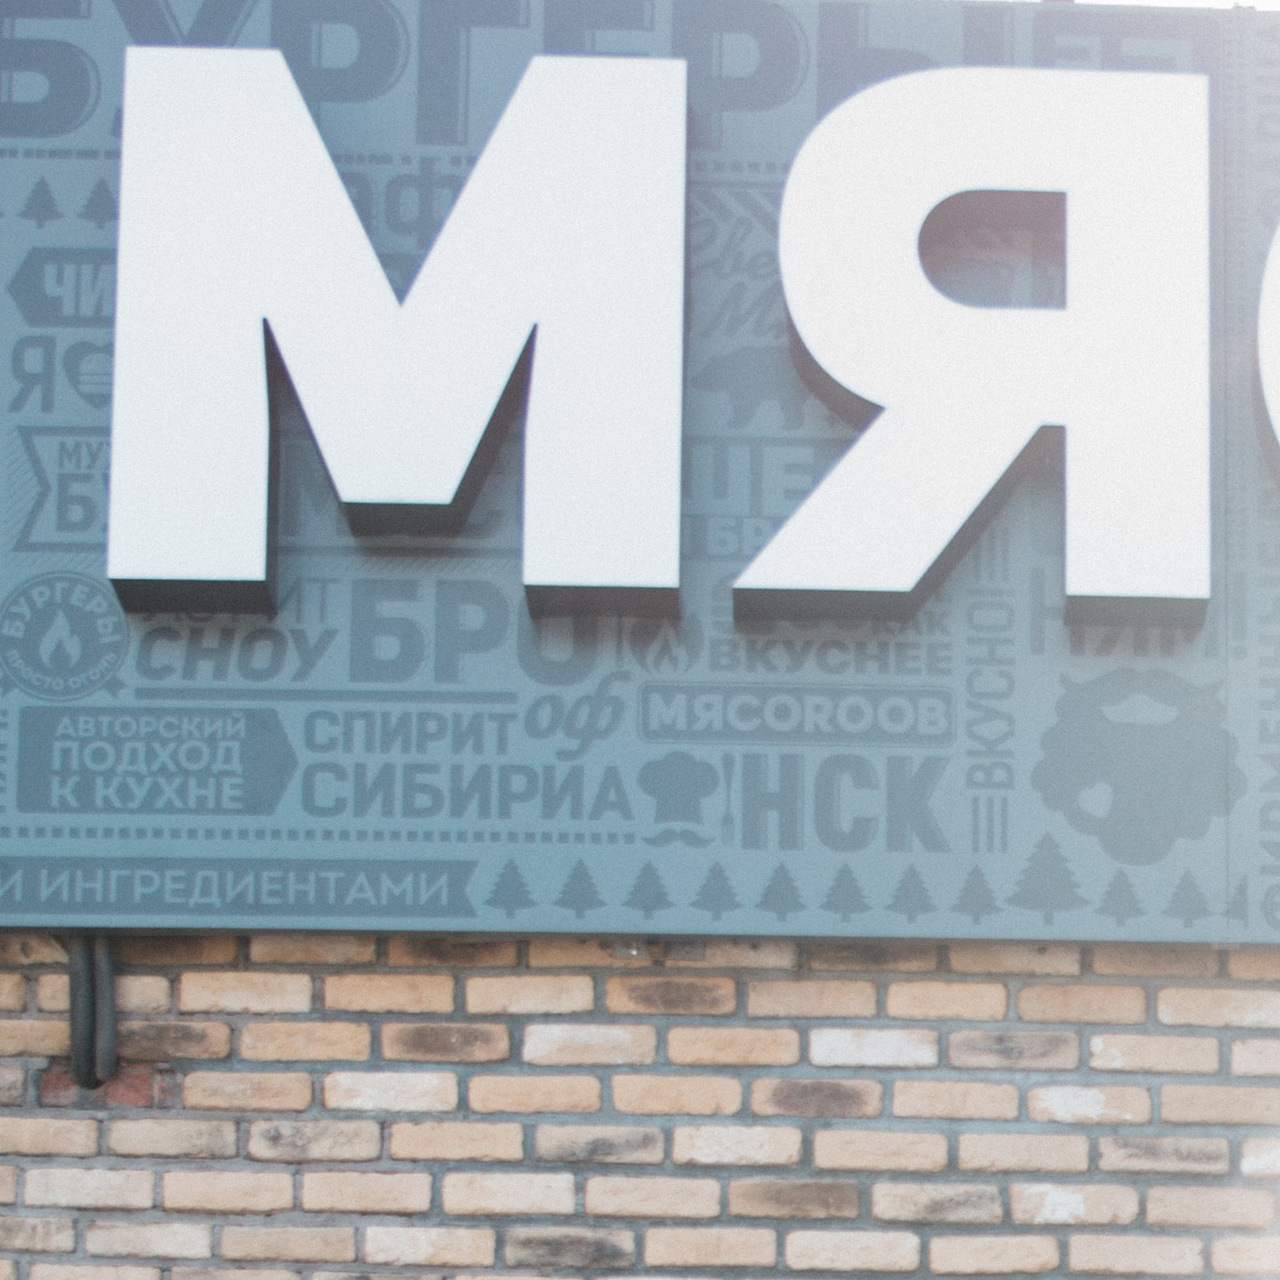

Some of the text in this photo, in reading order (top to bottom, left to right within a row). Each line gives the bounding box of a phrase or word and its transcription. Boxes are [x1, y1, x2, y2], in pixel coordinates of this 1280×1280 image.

[134, 624, 340, 683] СНОУ
[707, 638, 953, 677] ВКУСНЕЕ
[54, 710, 247, 740] АВТОРСКИЙ
[303, 709, 520, 756] СПИРИТ
[52, 741, 244, 776] ПОДХОД
[51, 777, 245, 811] К КУХНЕ
[301, 762, 636, 822] СИБИРИА
[741, 752, 953, 855] НСК
[39, 869, 450, 910] ИНГРЕДИЕНТАМИ
